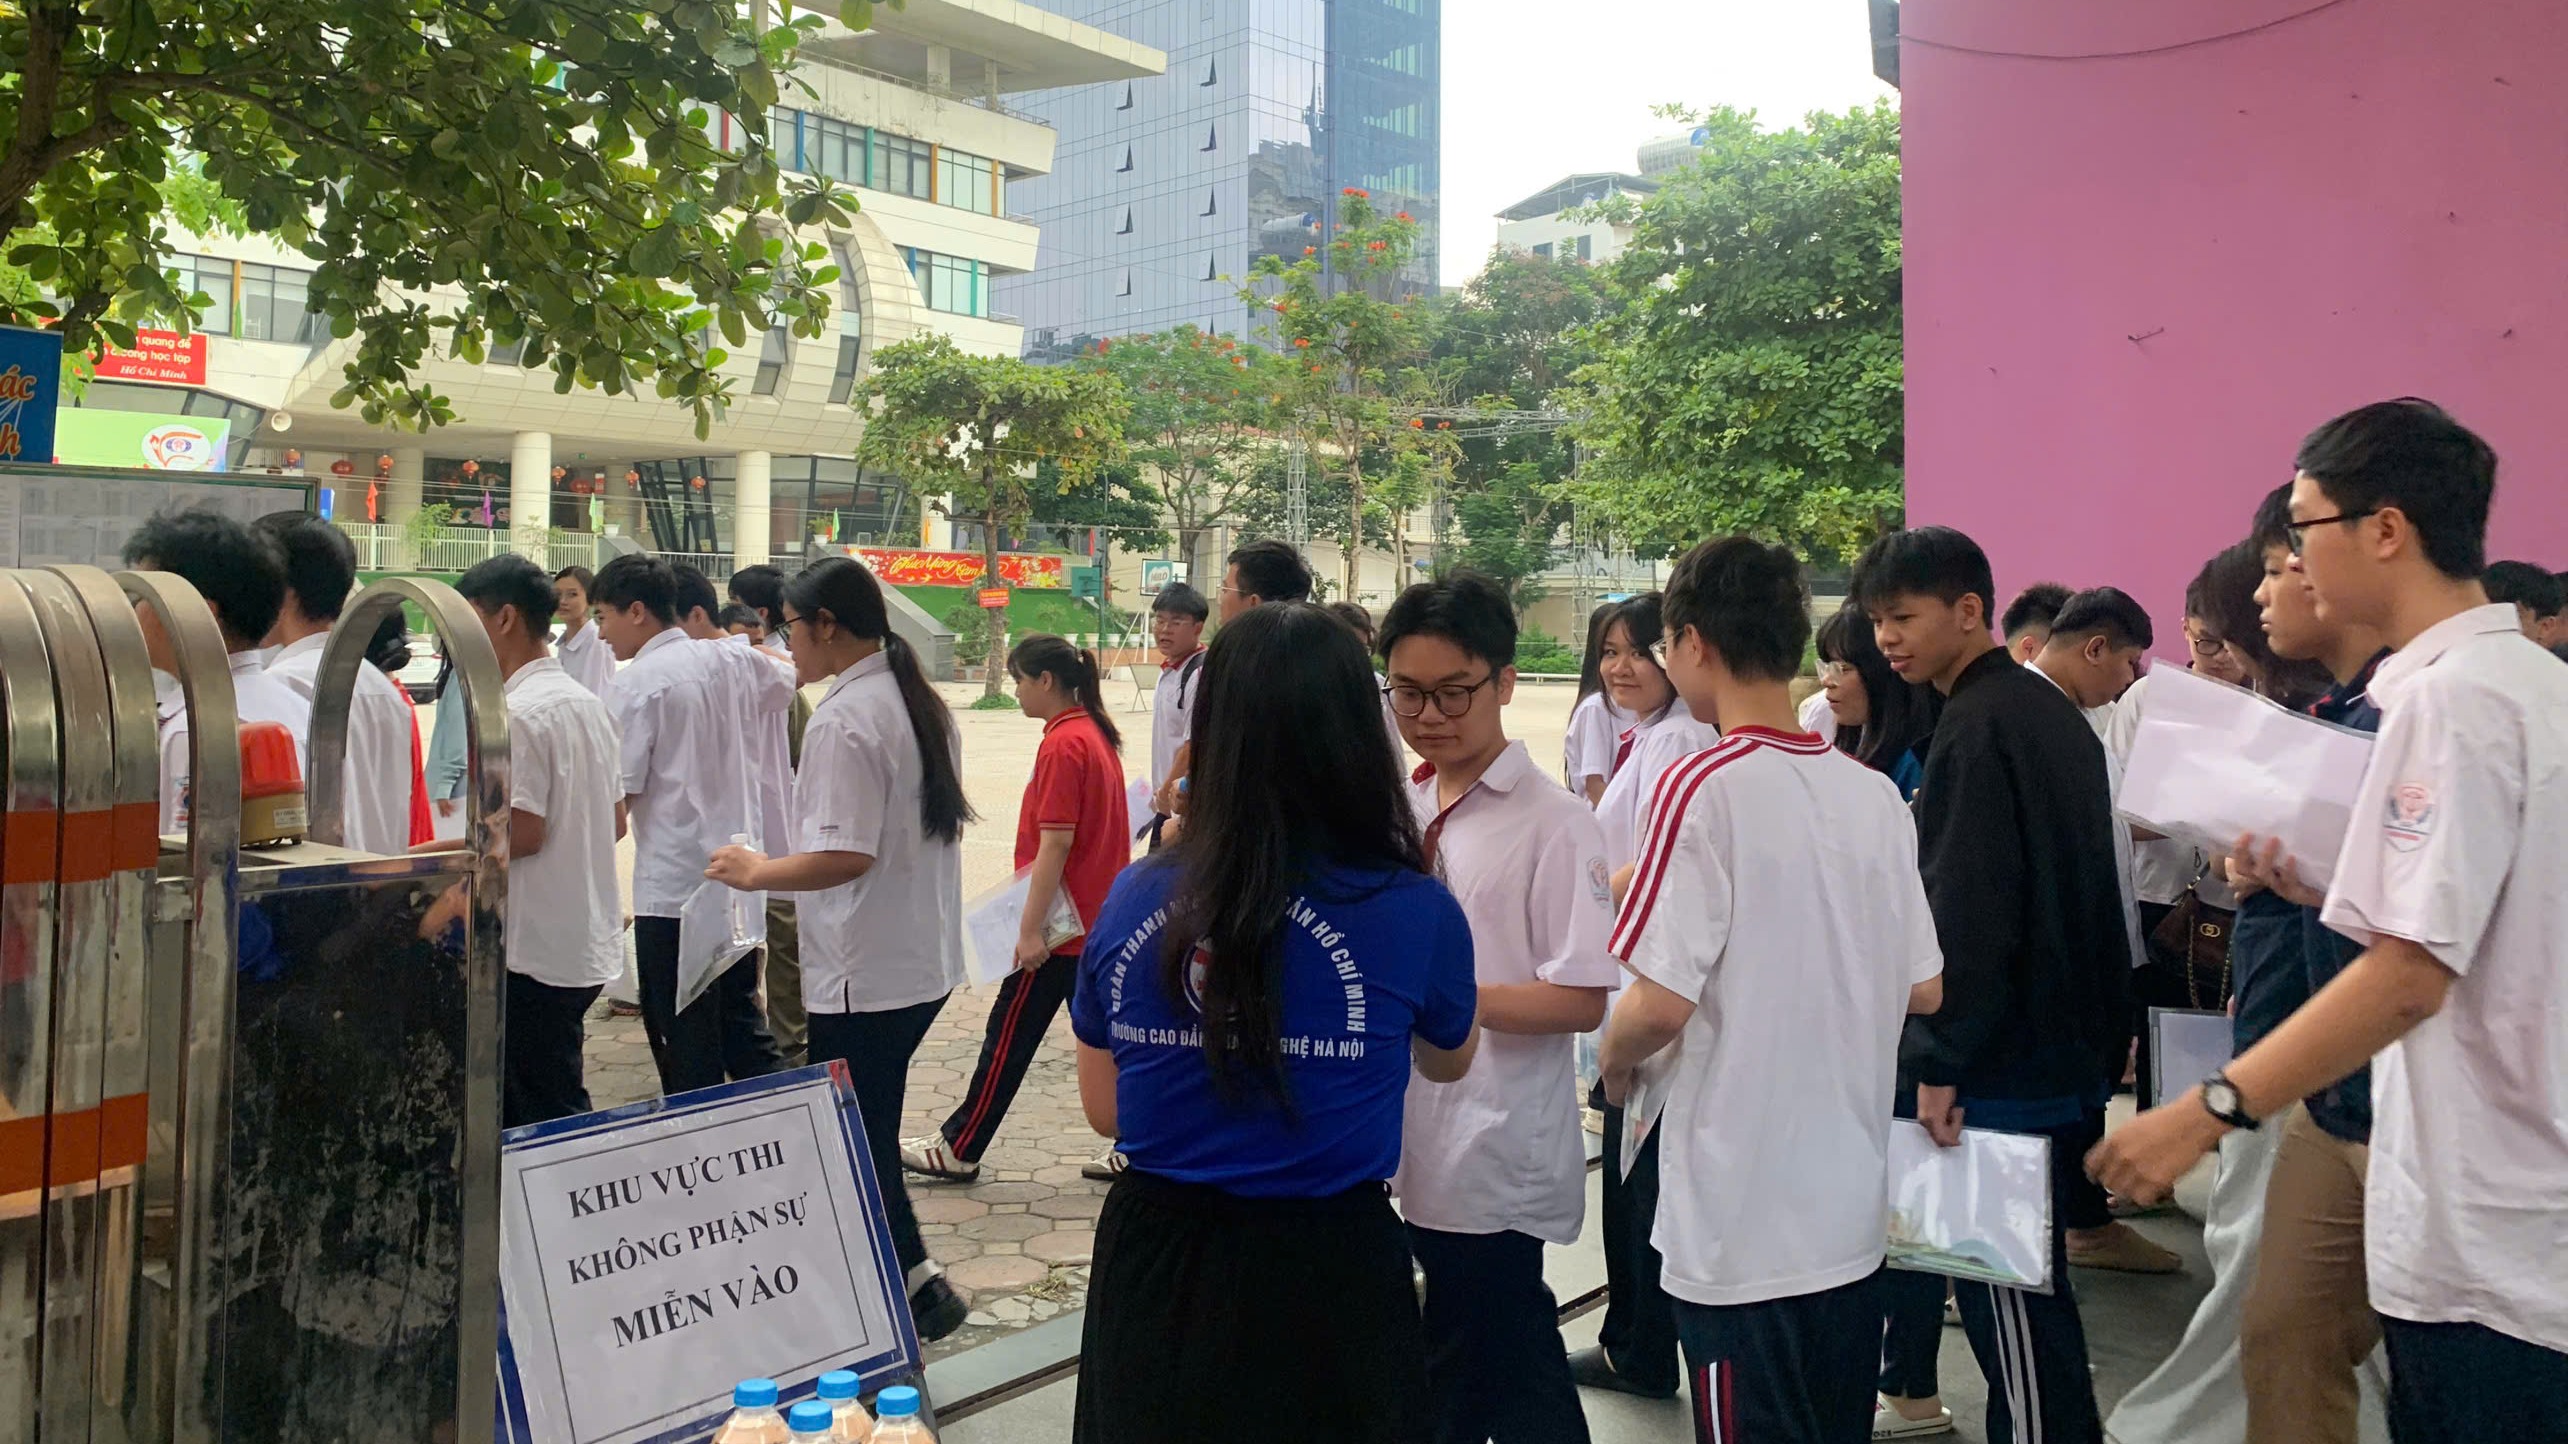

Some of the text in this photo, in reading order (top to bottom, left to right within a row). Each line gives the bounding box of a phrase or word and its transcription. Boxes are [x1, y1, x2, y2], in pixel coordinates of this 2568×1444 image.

[142, 336, 175, 350] quang
[150, 350, 171, 363] học
[159, 369, 188, 380] Minh
[1121, 908, 1168, 962] THANH
[1284, 896, 1366, 1033] ẢN HỒ CHÍ MINH
[1150, 1028, 1177, 1046] CAO
[1279, 1035, 1310, 1059] GHỆ
[1314, 1038, 1335, 1058] HÀ
[1338, 1037, 1364, 1061] NỘI
[567, 1140, 785, 1219] KHU VỰC THI
[567, 1191, 808, 1285] KHÔNG PHẬN SỰ
[610, 1264, 799, 1349] MIỄN VÀO
